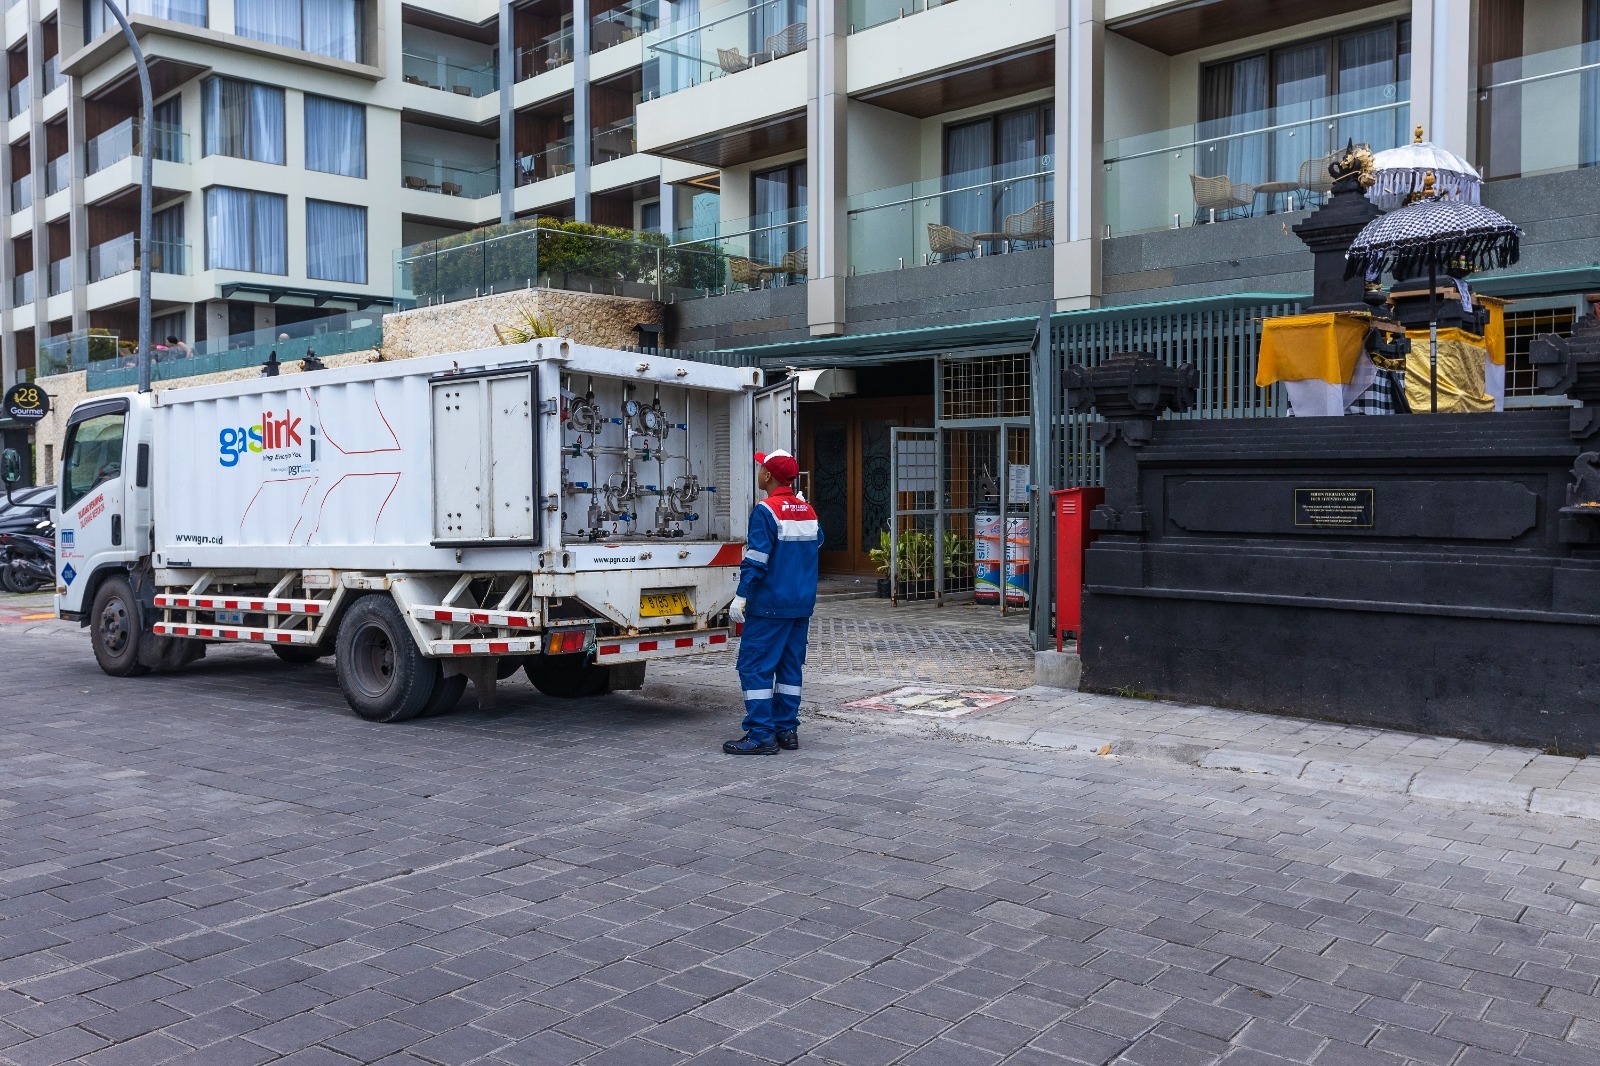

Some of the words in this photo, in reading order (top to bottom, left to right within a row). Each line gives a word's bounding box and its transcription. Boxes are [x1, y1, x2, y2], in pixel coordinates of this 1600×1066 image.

[19, 388, 38, 402] 28
[10, 406, 44, 415] Gourmet
[219, 408, 302, 467] gaslink
[576, 434, 582, 444] 4
[643, 439, 649, 450] 5
[612, 522, 618, 534] 2
[593, 556, 636, 565] www.pgn.co.id
